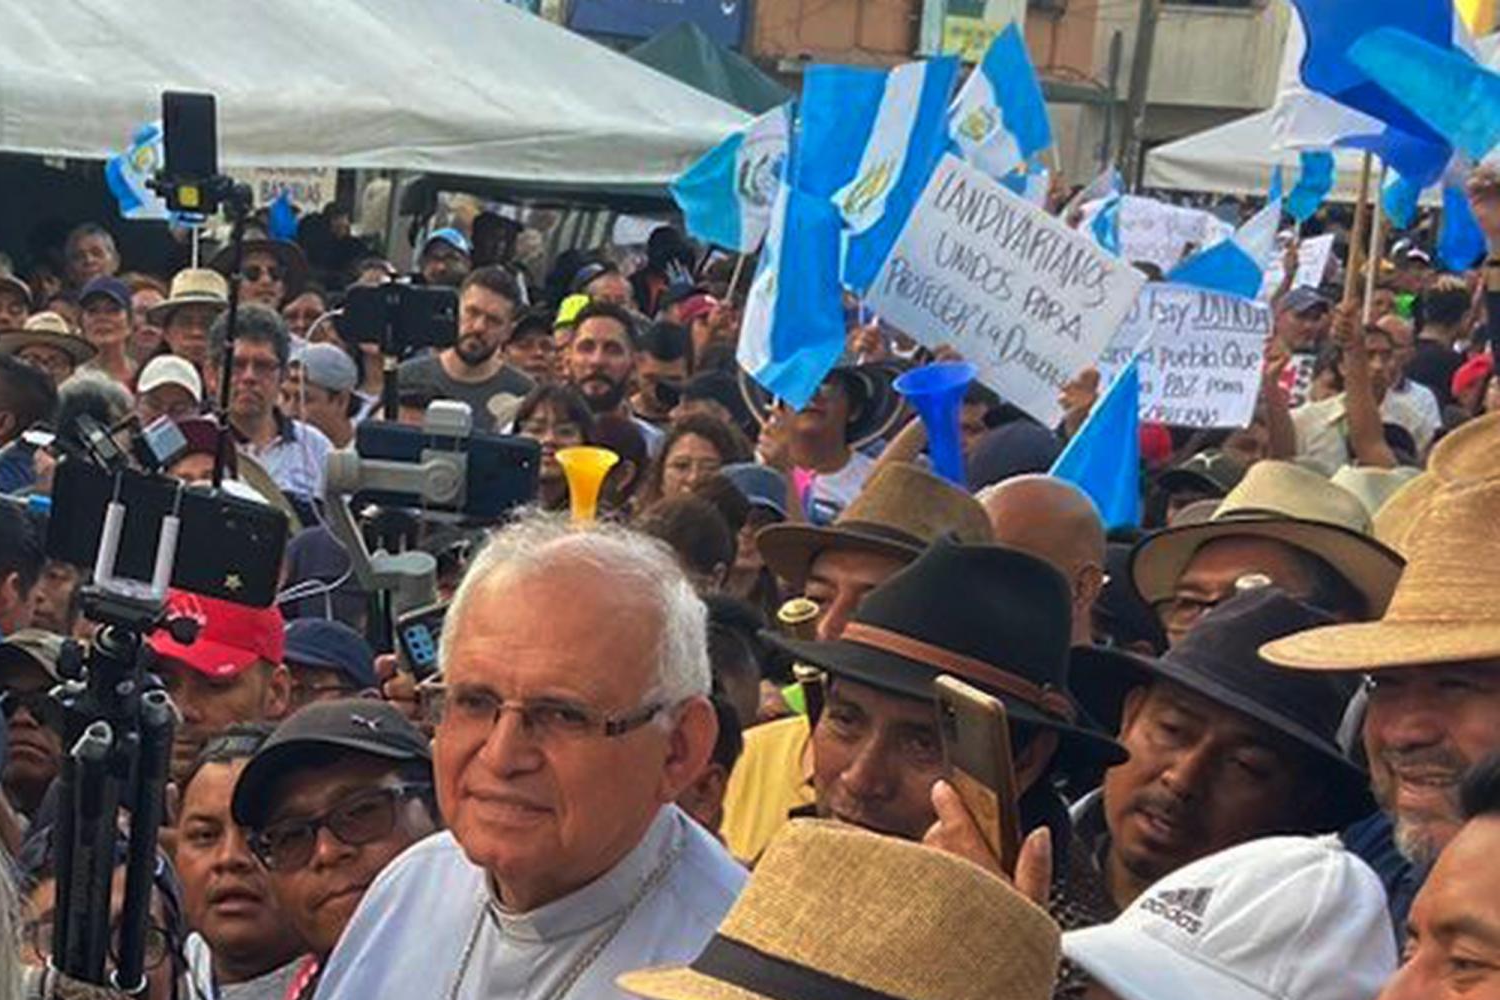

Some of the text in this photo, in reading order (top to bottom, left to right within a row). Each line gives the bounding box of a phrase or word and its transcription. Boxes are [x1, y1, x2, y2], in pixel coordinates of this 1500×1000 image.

[934, 230, 1013, 302] UNIDOS
[1022, 285, 1084, 342] PARA
[1141, 898, 1202, 934] adidas
